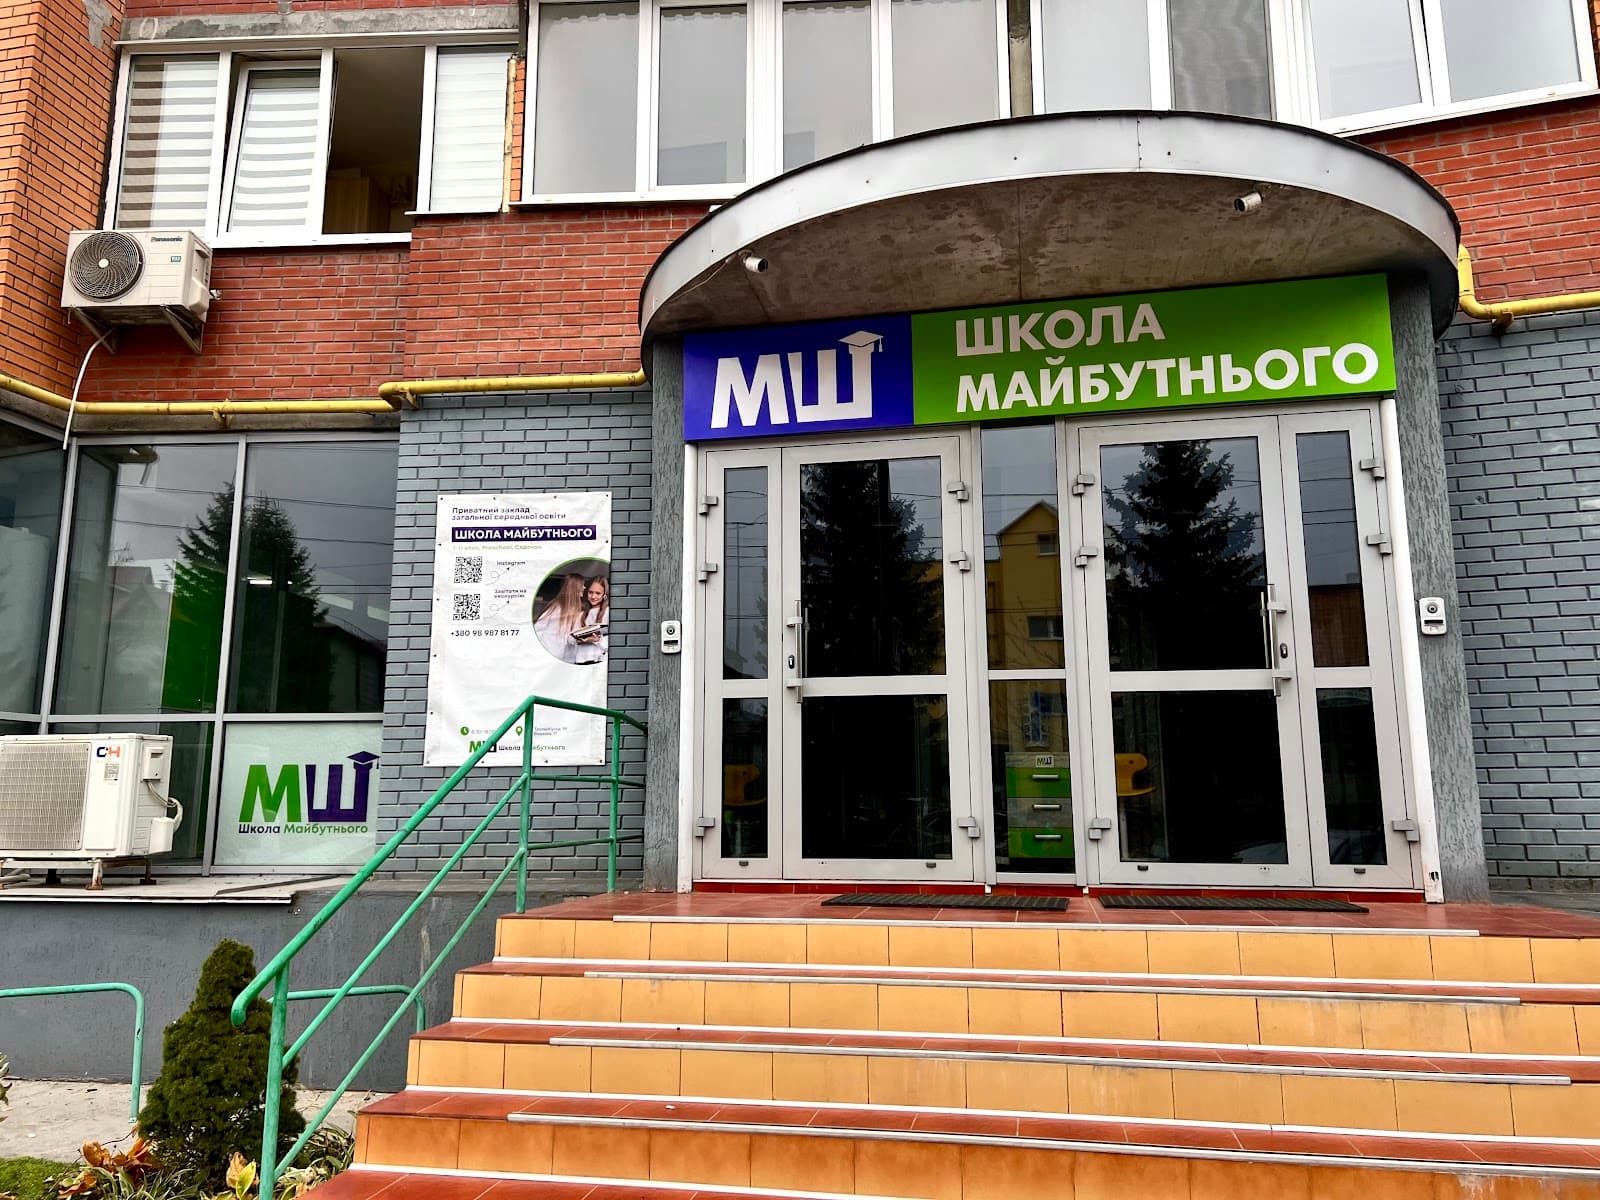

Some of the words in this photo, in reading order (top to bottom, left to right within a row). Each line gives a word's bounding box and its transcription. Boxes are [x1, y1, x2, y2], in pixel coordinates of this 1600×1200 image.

[956, 303, 1166, 357] ШКОЛА
[711, 342, 875, 429] МШ
[957, 342, 1379, 413] МАЙБУТНЬОГО
[455, 529, 502, 540] ШКОЛА
[503, 527, 593, 539] МАЙБУТНЬОГО
[494, 513, 538, 521] середньої
[450, 629, 471, 637] +380
[472, 629, 482, 637] 98
[484, 629, 499, 637] 987
[500, 629, 509, 637] 81
[239, 761, 373, 823] МШ
[238, 823, 281, 834] Школа
[283, 823, 368, 836] Майбутнього
